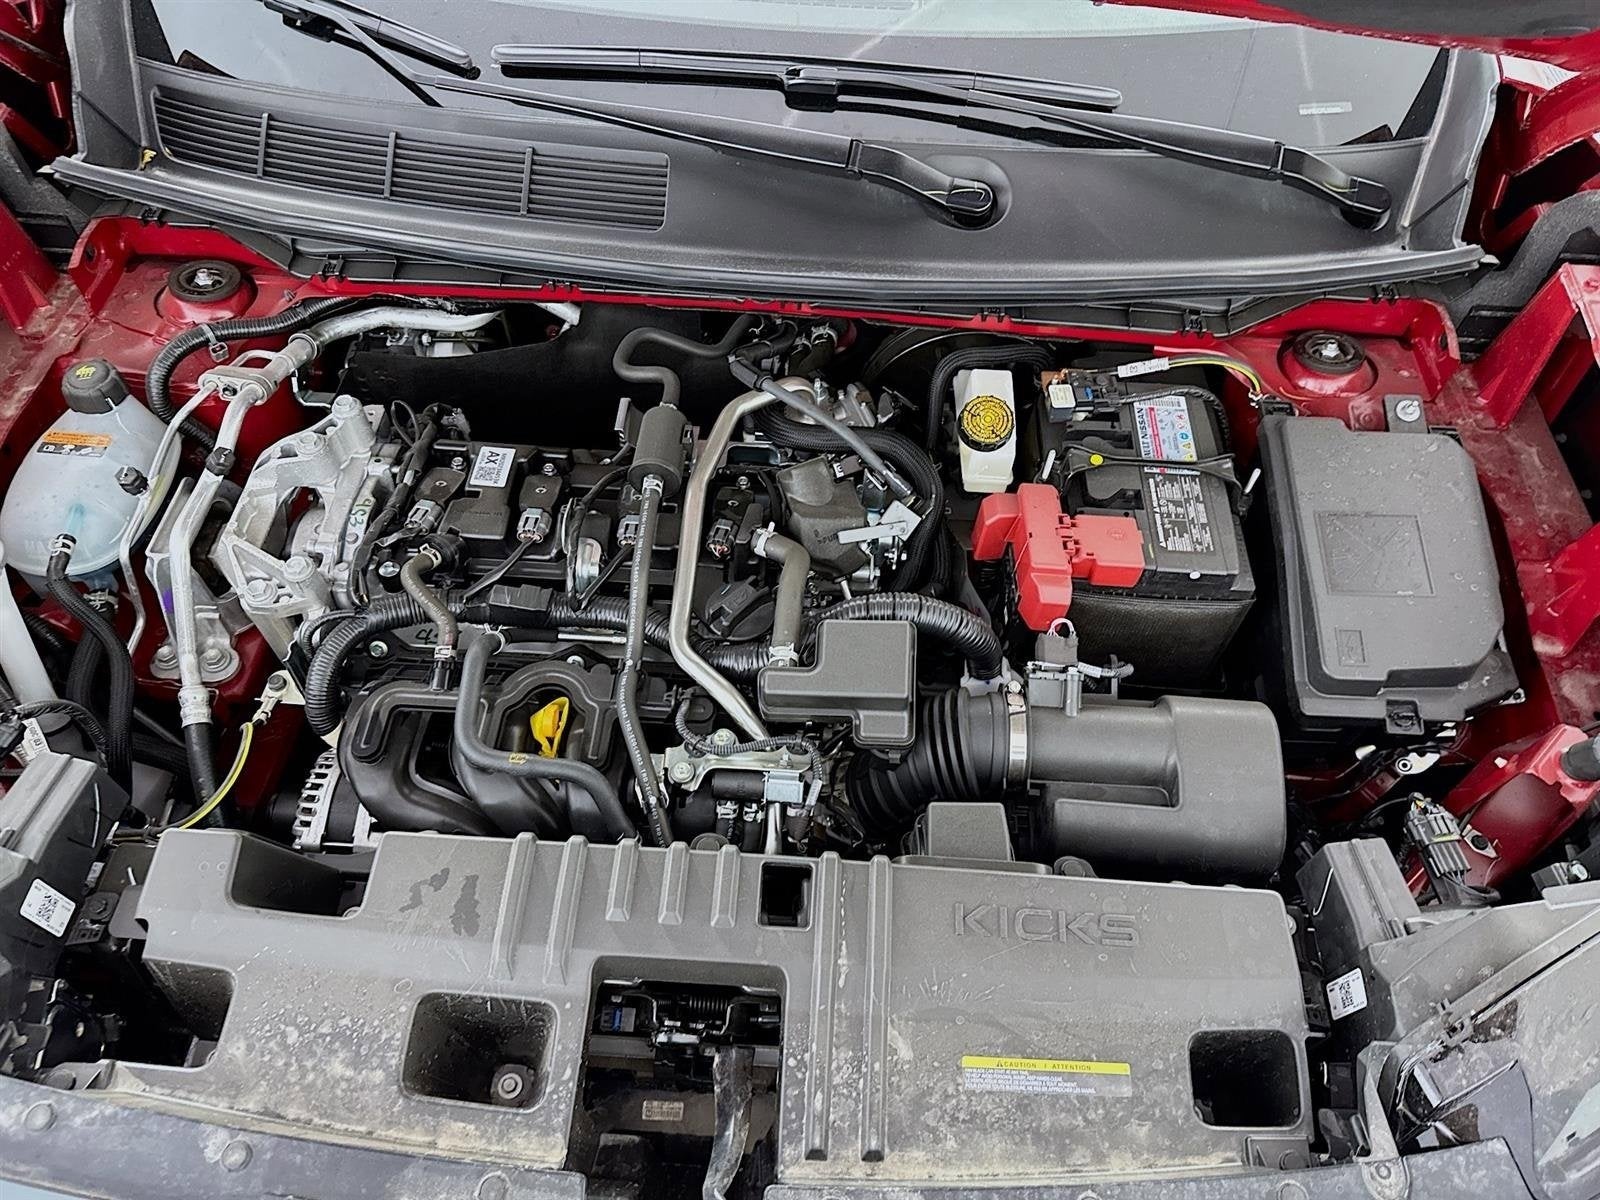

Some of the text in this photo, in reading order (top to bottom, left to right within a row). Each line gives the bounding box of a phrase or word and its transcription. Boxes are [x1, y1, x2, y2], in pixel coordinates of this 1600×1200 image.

[1136, 407, 1148, 439] NISSAN
[485, 450, 500, 464] AX
[954, 902, 1140, 948] KICKS
[1004, 1061, 1037, 1069] CAUTION
[1052, 1063, 1092, 1071] ATTENTION
